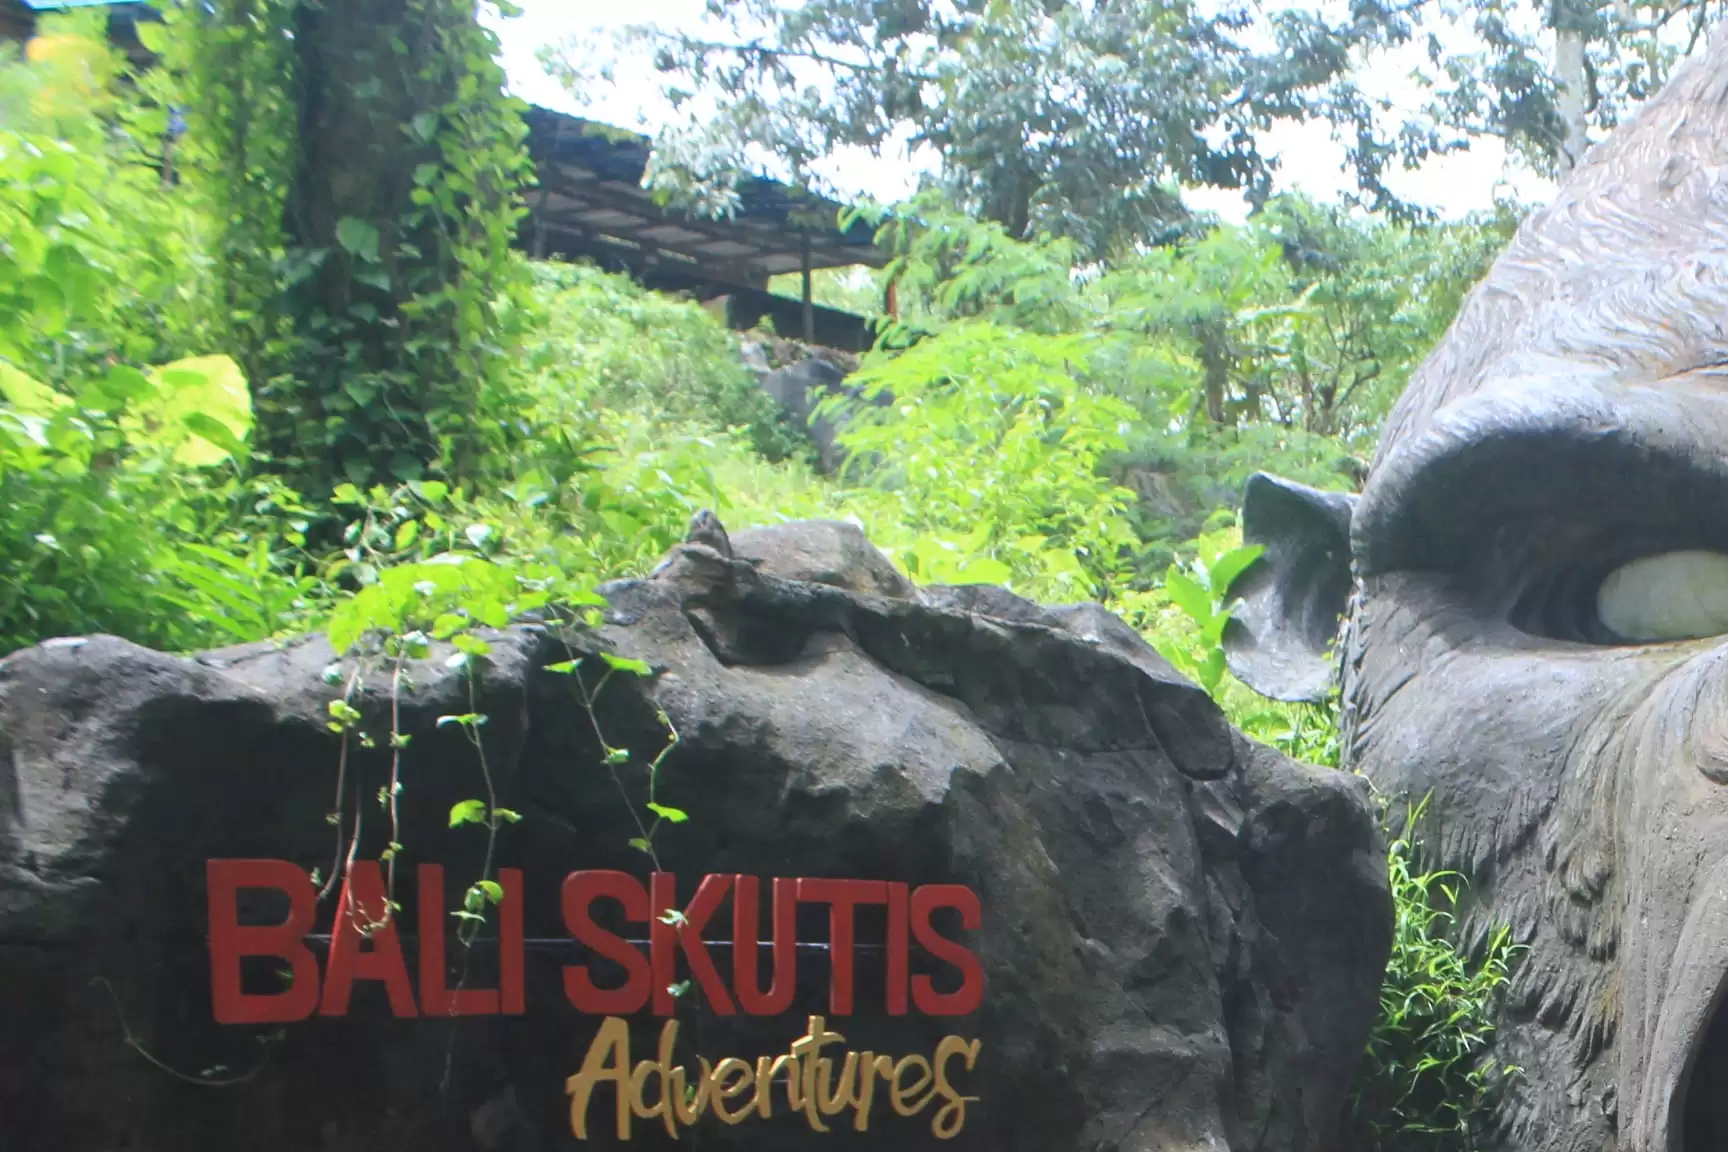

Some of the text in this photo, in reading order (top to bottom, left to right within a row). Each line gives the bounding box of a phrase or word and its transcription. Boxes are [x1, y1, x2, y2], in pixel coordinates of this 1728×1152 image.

[206, 858, 986, 1024] BALI SKUTIS
[565, 1015, 981, 1140] Adventures
